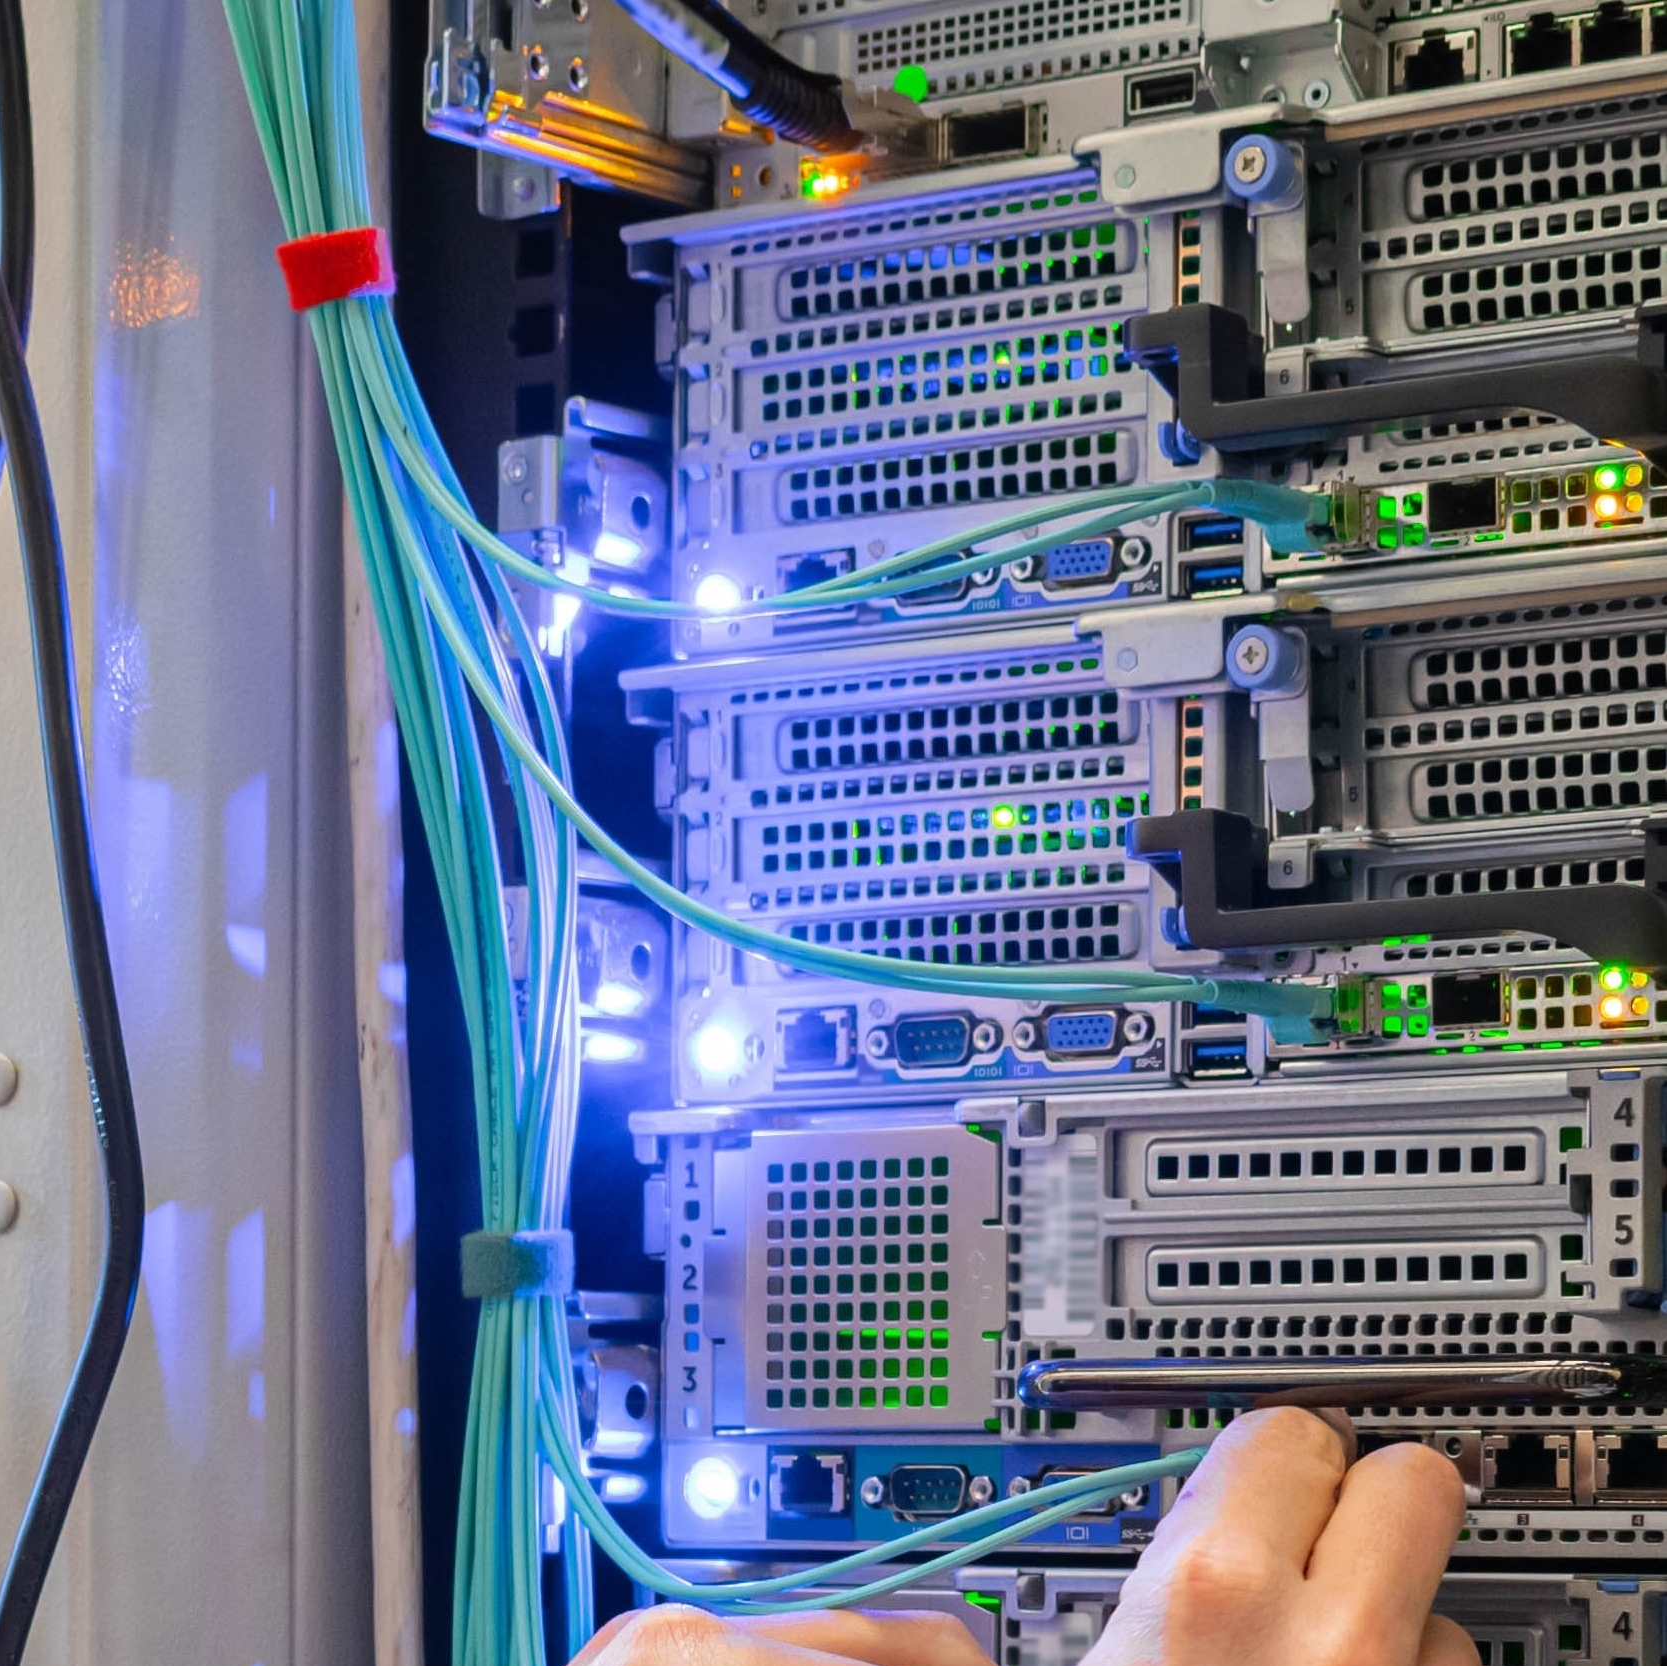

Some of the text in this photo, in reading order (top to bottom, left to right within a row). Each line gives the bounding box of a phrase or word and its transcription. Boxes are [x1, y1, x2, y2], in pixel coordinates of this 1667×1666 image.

[1280, 369, 1289, 385] 6
[1462, 536, 1470, 547] 2
[1349, 786, 1358, 803] 5
[1283, 859, 1293, 876] 6
[1340, 956, 1347, 970] 1
[1469, 1030, 1476, 1042] 2
[1613, 1098, 1636, 1128] 4
[685, 1161, 698, 1188] 1
[1614, 1214, 1634, 1245] 5
[683, 1264, 698, 1292] 2
[683, 1366, 698, 1393] 3
[1519, 1514, 1642, 1526] 3 4
[1612, 1611, 1633, 1641] 4
